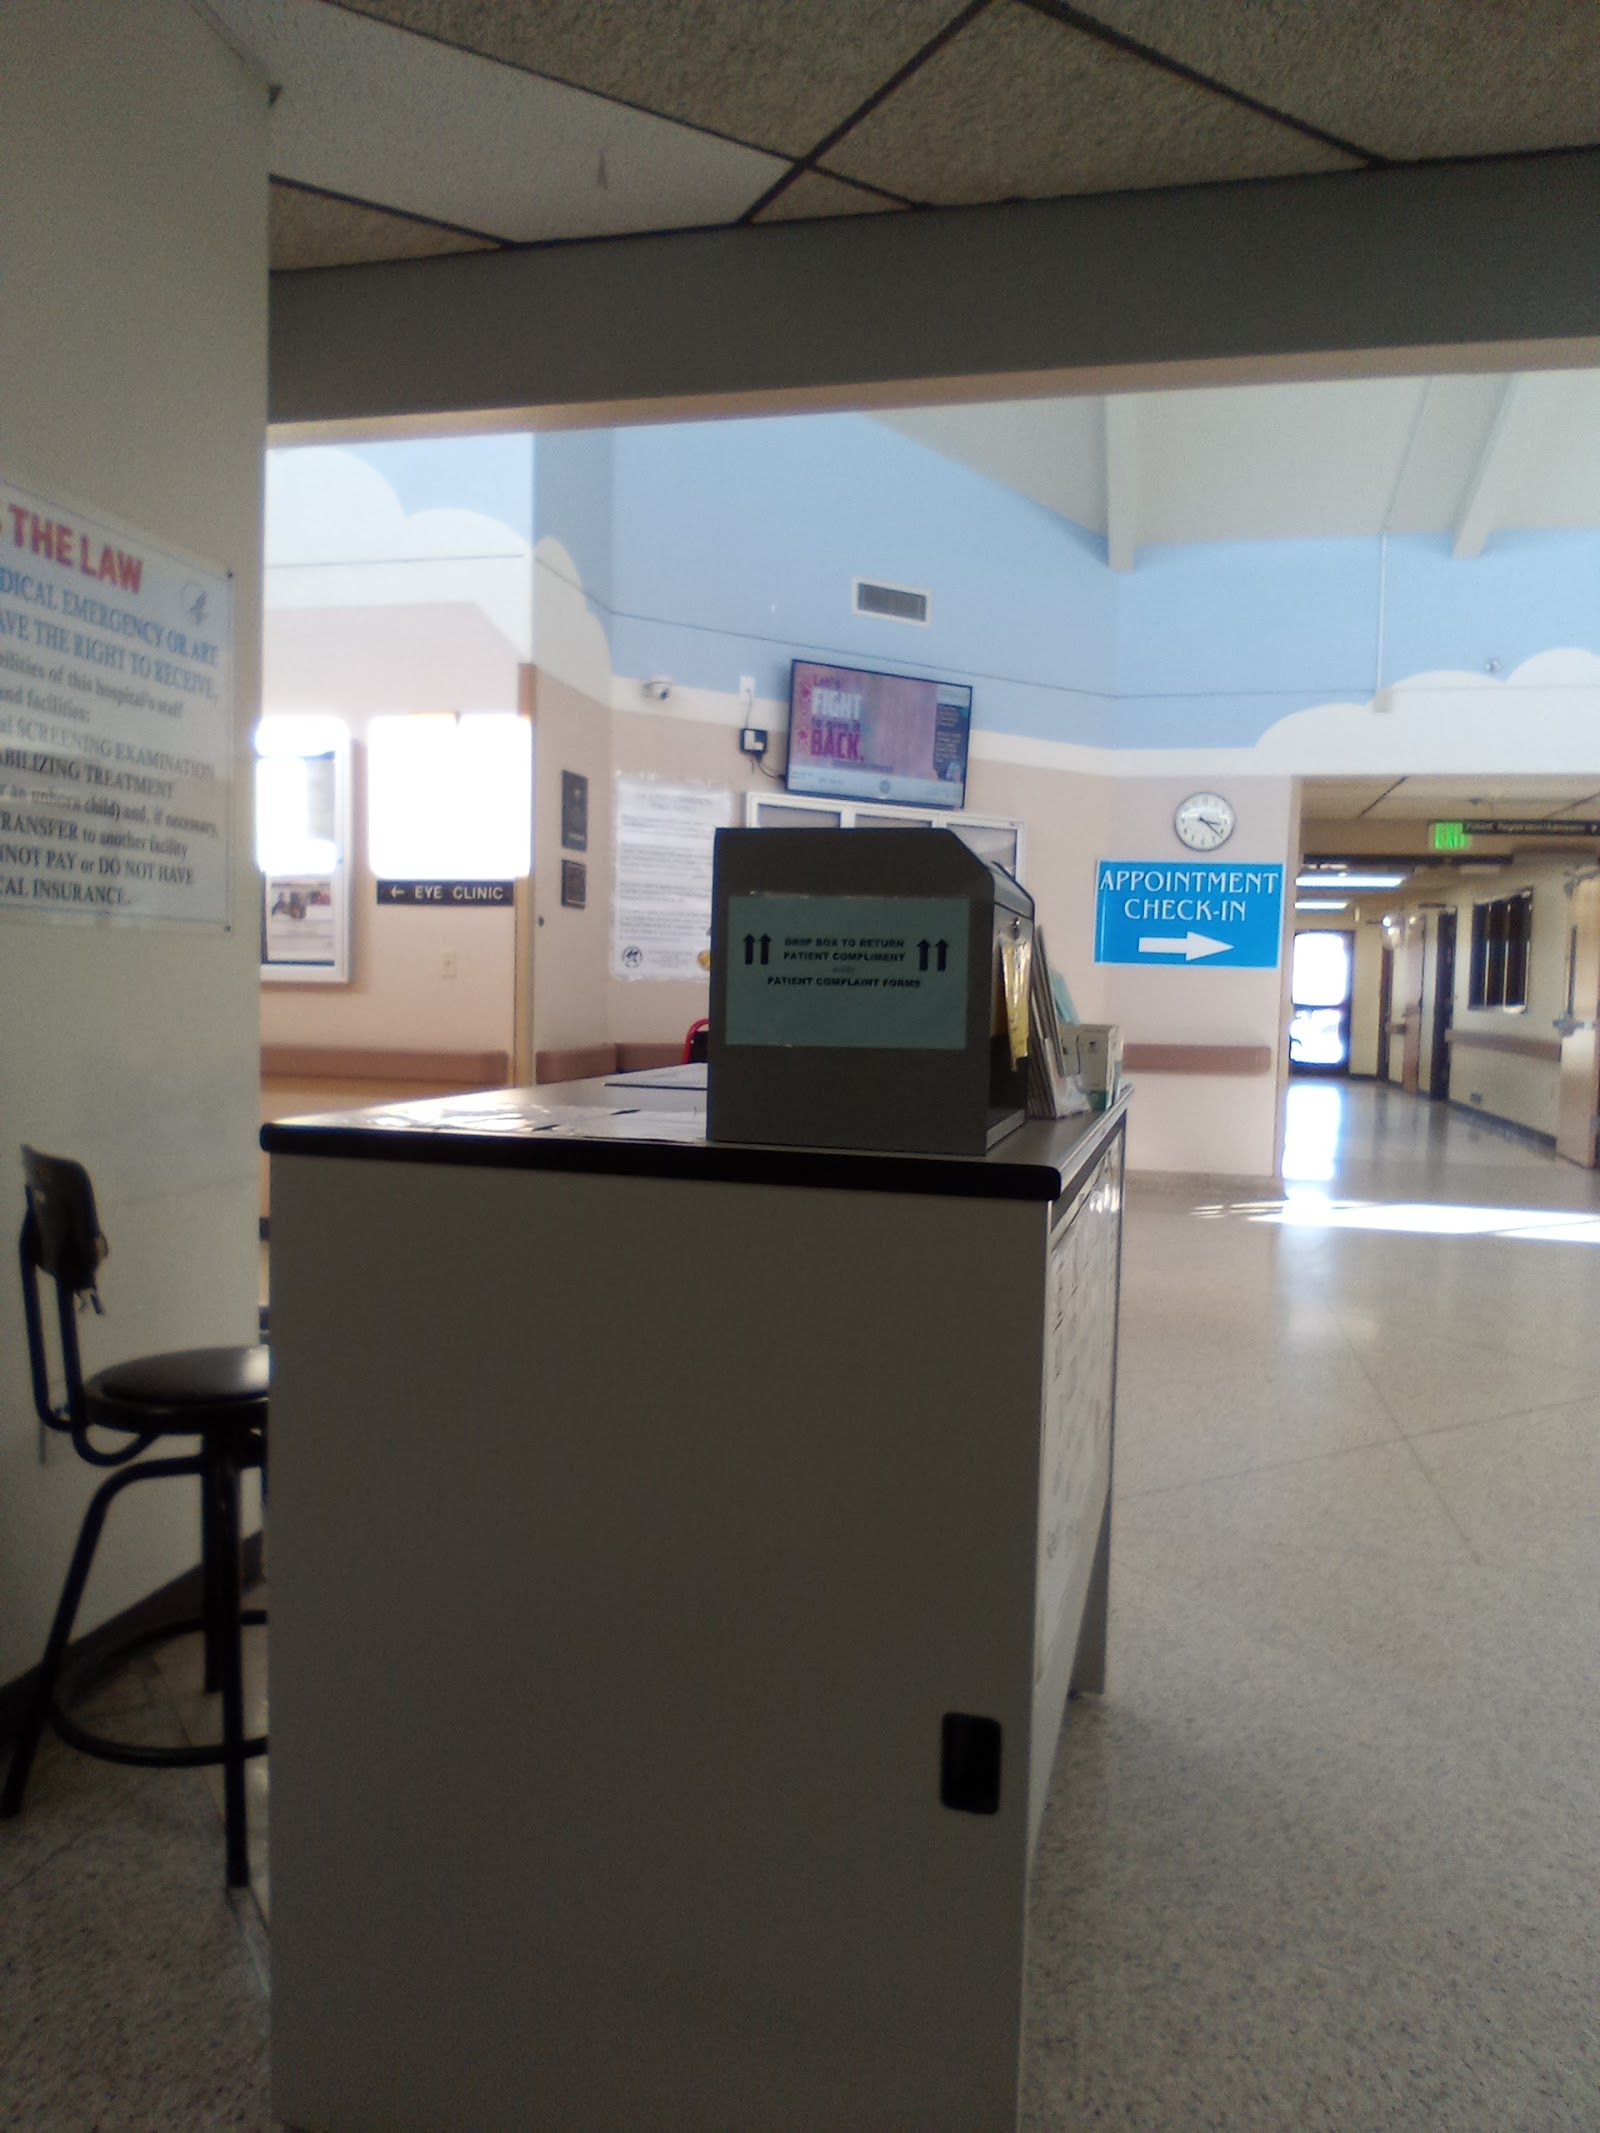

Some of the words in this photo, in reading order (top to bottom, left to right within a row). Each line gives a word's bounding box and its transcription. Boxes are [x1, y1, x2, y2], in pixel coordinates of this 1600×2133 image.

[8, 503, 74, 569] THE
[80, 534, 144, 595] LAW
[62, 588, 164, 649] EMERGENCY
[34, 620, 69, 654] THE
[73, 632, 126, 672] RIGHT
[130, 652, 151, 679] TO
[811, 688, 863, 720] FIGHT
[84, 763, 176, 800] TREATMENT
[83, 828, 96, 843] to
[100, 829, 146, 849] another
[45, 849, 78, 871] PAY
[80, 860, 95, 873] or
[99, 855, 121, 876] DO
[125, 860, 154, 880] NOT
[157, 862, 194, 885] HAVE
[414, 885, 443, 900] EYE
[452, 886, 504, 900] CLINIC
[1100, 870, 1279, 894] APPOINTMENT
[1124, 899, 1247, 921] CHECK-IN
[784, 937, 812, 947] DROP
[815, 938, 838, 947] BOX
[842, 938, 856, 947] TO
[859, 938, 905, 948] RETURN
[783, 951, 829, 961] PATIENT
[832, 952, 906, 962] COMPLIMENT
[767, 976, 813, 985] PATIENT
[816, 977, 879, 987] COMPLAINT
[883, 978, 921, 988] FORMS
